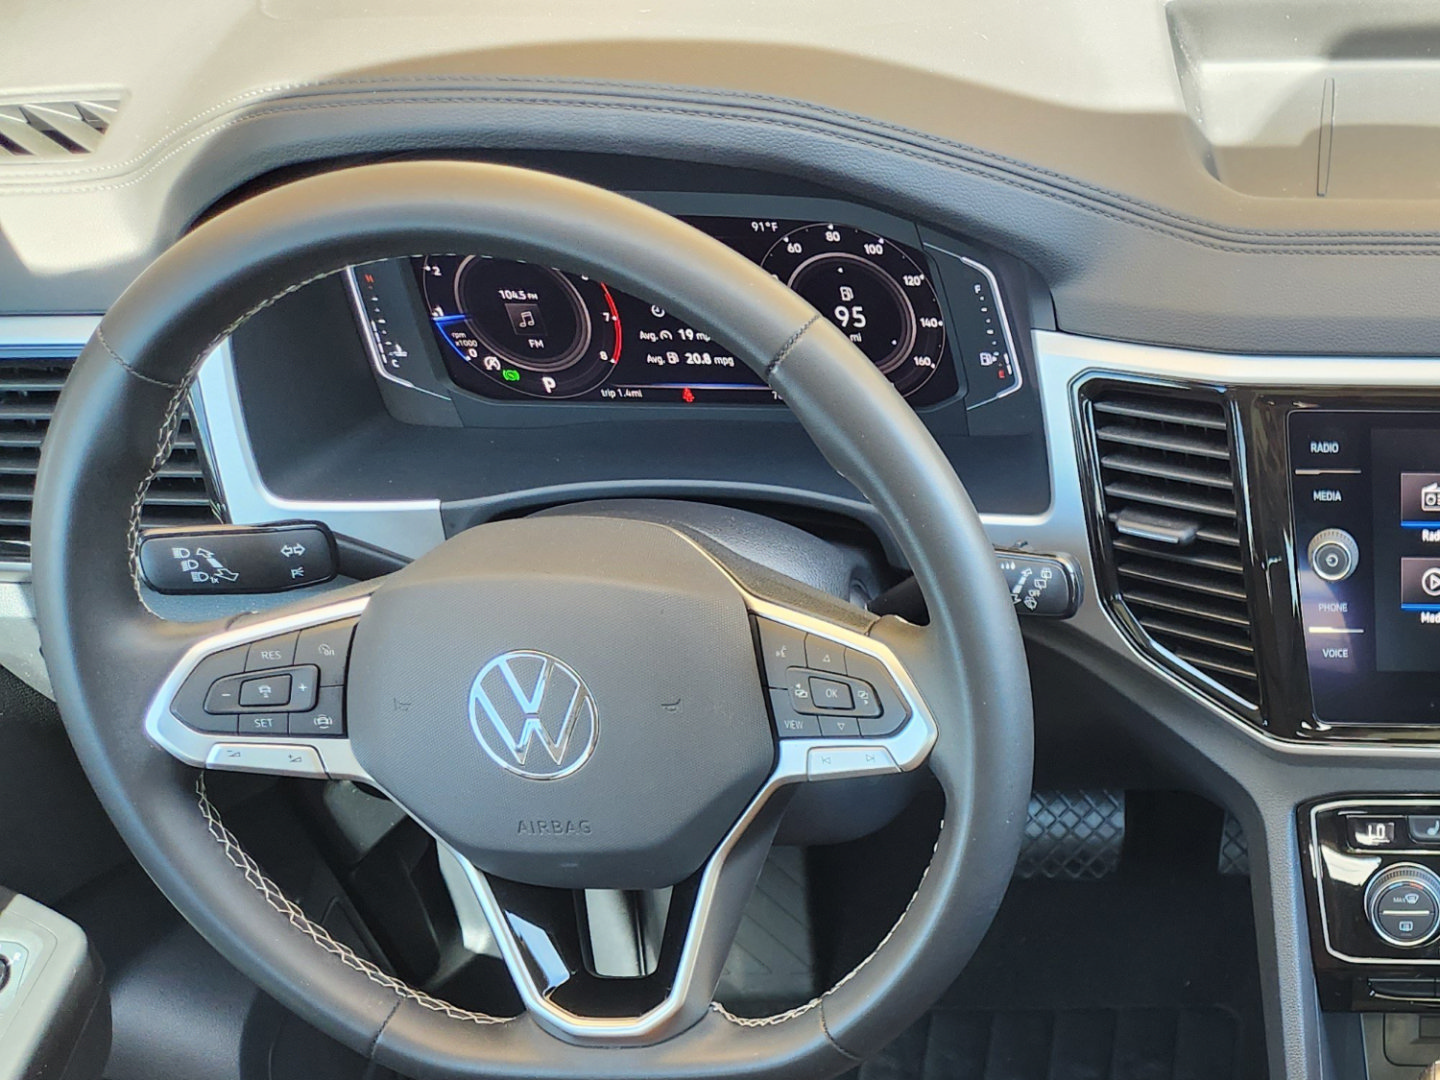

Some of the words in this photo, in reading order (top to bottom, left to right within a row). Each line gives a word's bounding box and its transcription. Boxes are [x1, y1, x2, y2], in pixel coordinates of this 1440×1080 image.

[825, 231, 841, 242] 80
[787, 243, 802, 253] 60
[864, 243, 883, 255] 100
[432, 265, 442, 276] 2
[903, 275, 921, 286] 120
[602, 312, 610, 322] 7
[834, 305, 866, 328] 95
[920, 317, 938, 328] 140
[639, 330, 659, 343] Avg.
[678, 328, 694, 341] 19
[528, 339, 545, 348] FM
[468, 348, 478, 358] 0
[599, 350, 609, 361] 8
[647, 354, 665, 366] Avg.
[684, 352, 712, 365] 20.8
[714, 356, 735, 367] mpg
[914, 356, 931, 367] 160
[541, 376, 556, 393] P
[600, 388, 616, 398] trip
[1310, 442, 1339, 453] RADIO
[1313, 490, 1342, 502] MEDIA
[1318, 602, 1348, 613] PHONE
[261, 650, 282, 660] RES
[1322, 648, 1349, 659] VOICE
[825, 688, 838, 698] OK
[254, 718, 273, 728] SET
[784, 720, 804, 730] VIEW
[517, 819, 592, 835] AIRBAG
